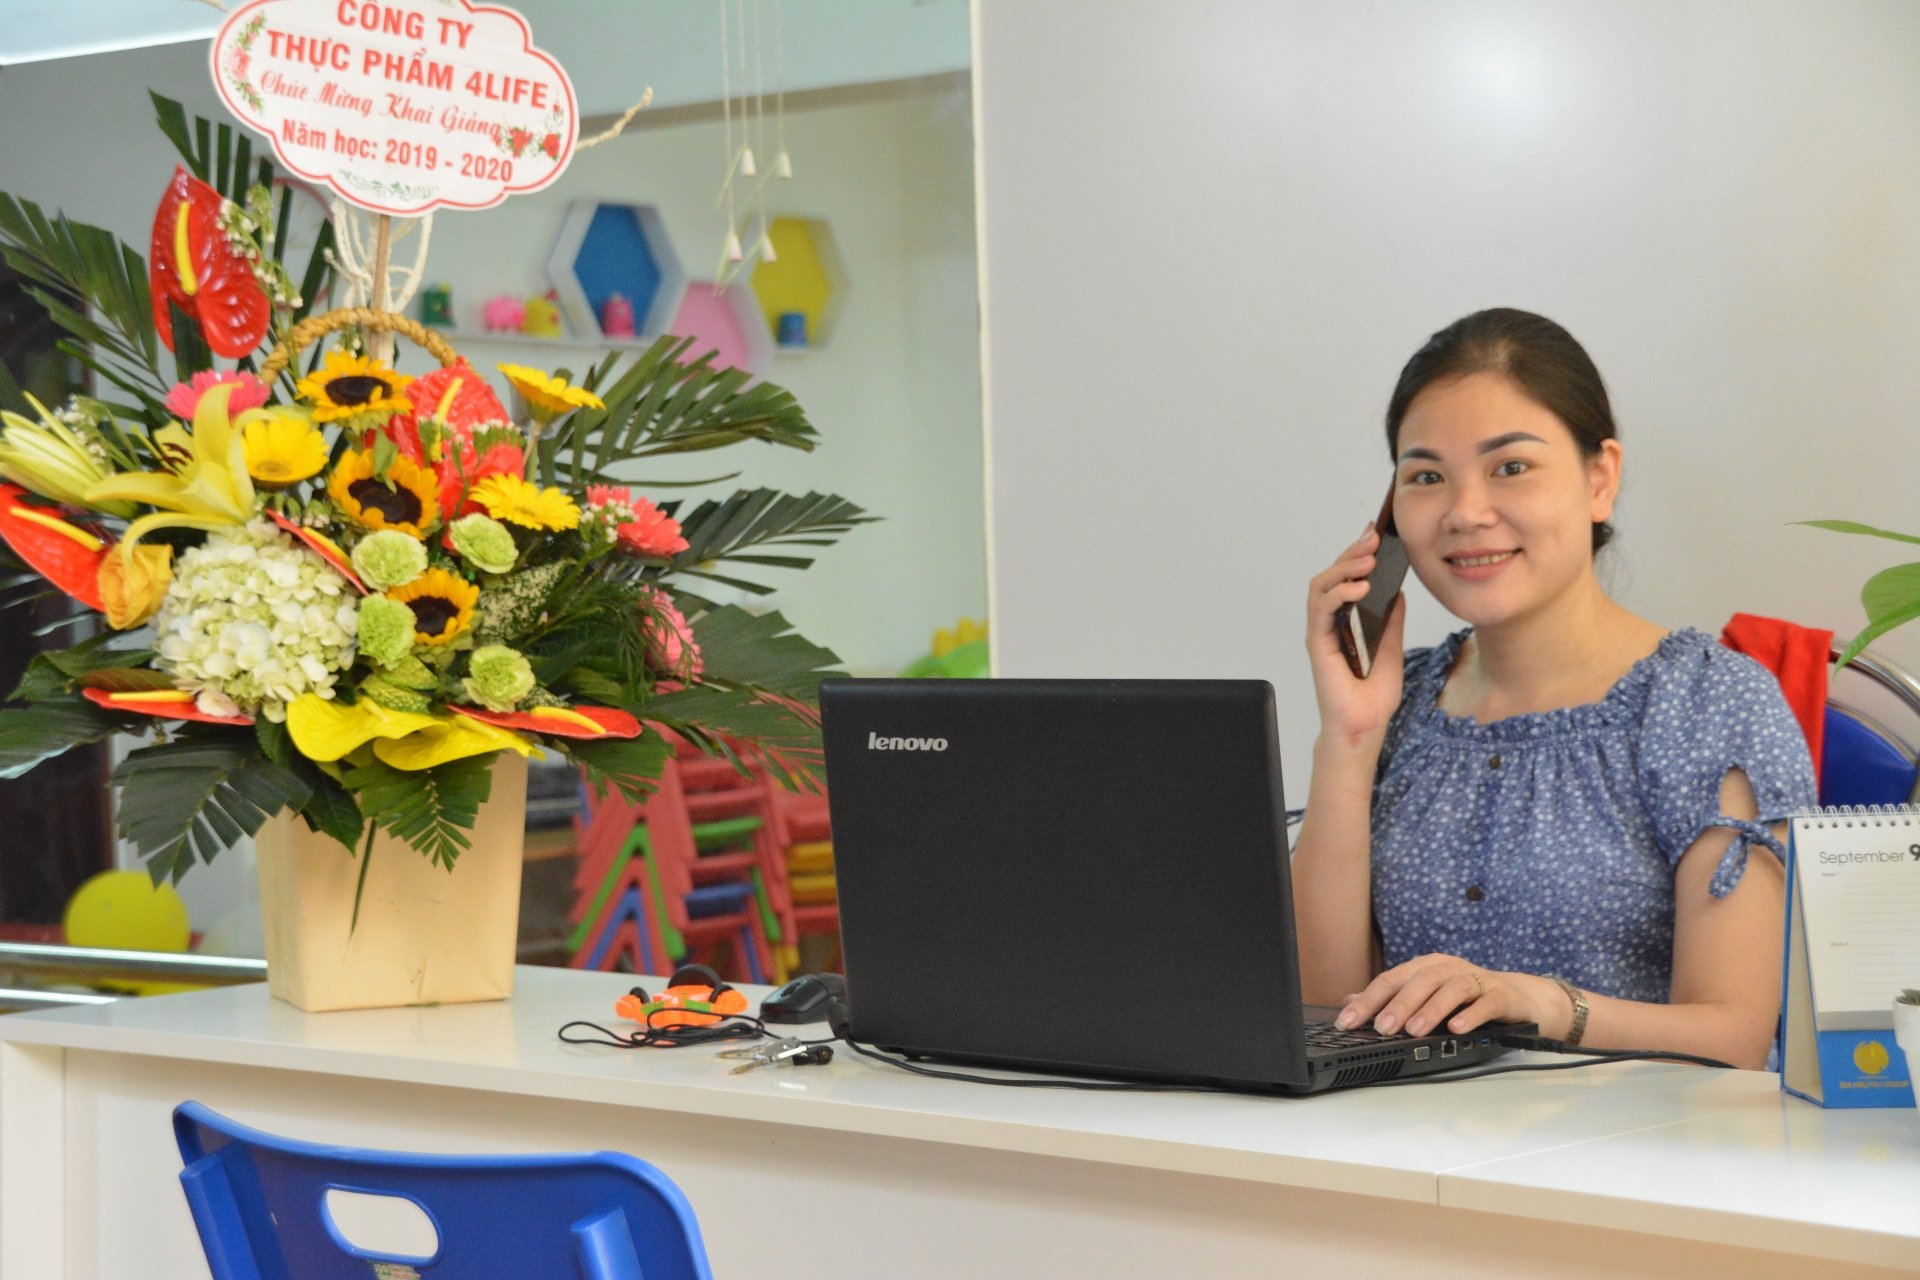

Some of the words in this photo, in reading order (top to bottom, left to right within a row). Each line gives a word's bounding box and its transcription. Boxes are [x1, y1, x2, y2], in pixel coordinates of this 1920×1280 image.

[438, 17, 475, 48] TY
[267, 30, 350, 73] THỰC
[363, 47, 454, 91] PHẨM
[465, 70, 548, 109] 4LIFE
[261, 70, 309, 101] Chúc
[313, 82, 373, 118] Mừng
[379, 93, 434, 125] Khai
[439, 106, 502, 146] Giảng
[283, 118, 327, 150] Năm
[334, 128, 378, 162] học:
[385, 139, 438, 171] 2019
[461, 153, 513, 182] 2020
[868, 732, 948, 751] lenovo
[1819, 850, 1905, 866] September
[1908, 843, 1920, 861] 9
